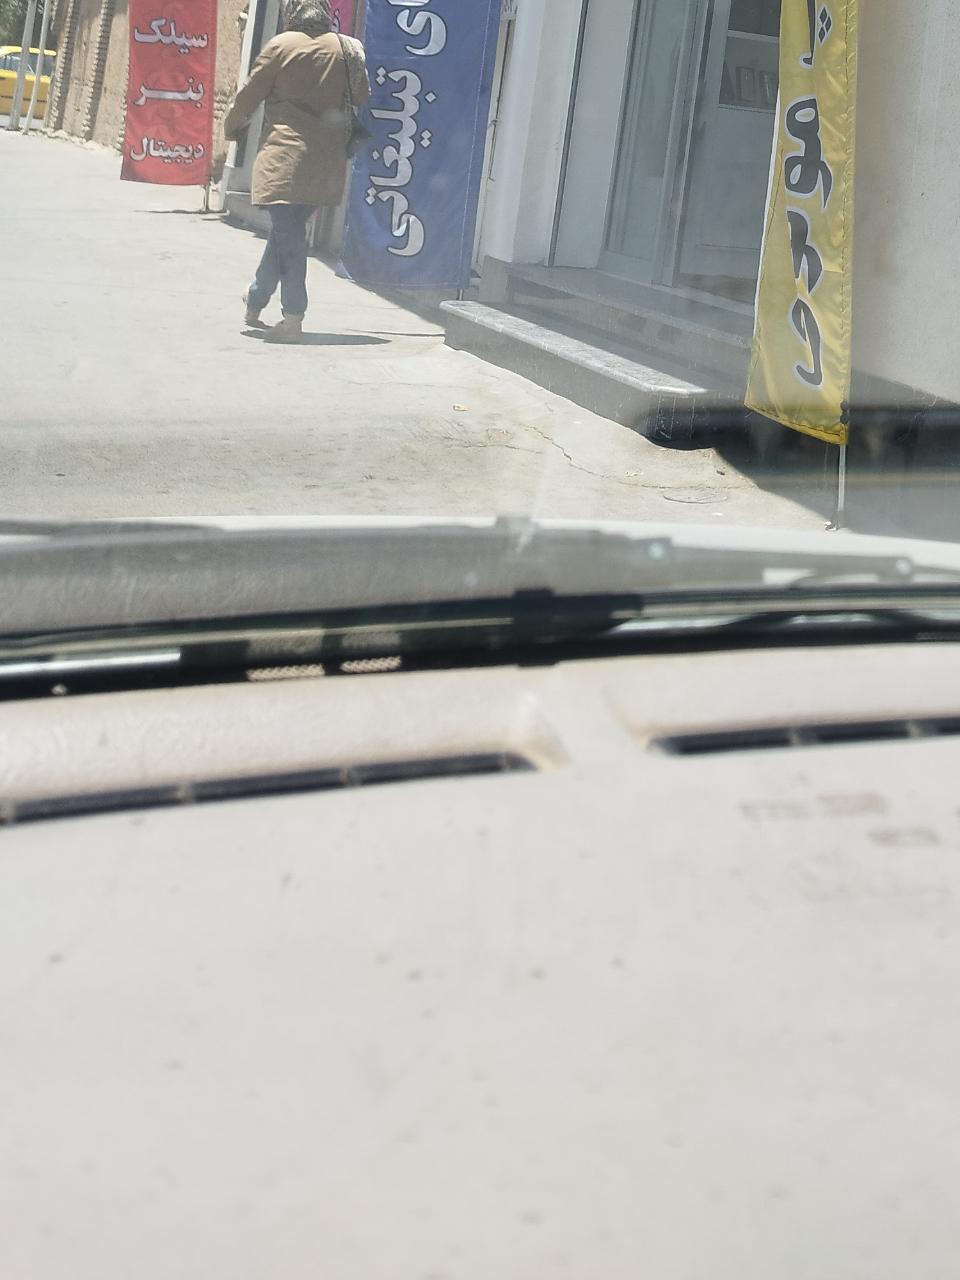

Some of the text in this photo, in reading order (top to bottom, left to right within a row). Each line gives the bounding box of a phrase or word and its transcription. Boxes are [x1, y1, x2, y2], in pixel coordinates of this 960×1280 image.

[134, 18, 208, 54] سیلک
[134, 77, 205, 109] بنر
[130, 136, 205, 164] دیجیتال
[364, 66, 436, 258] تبلیغاتی
